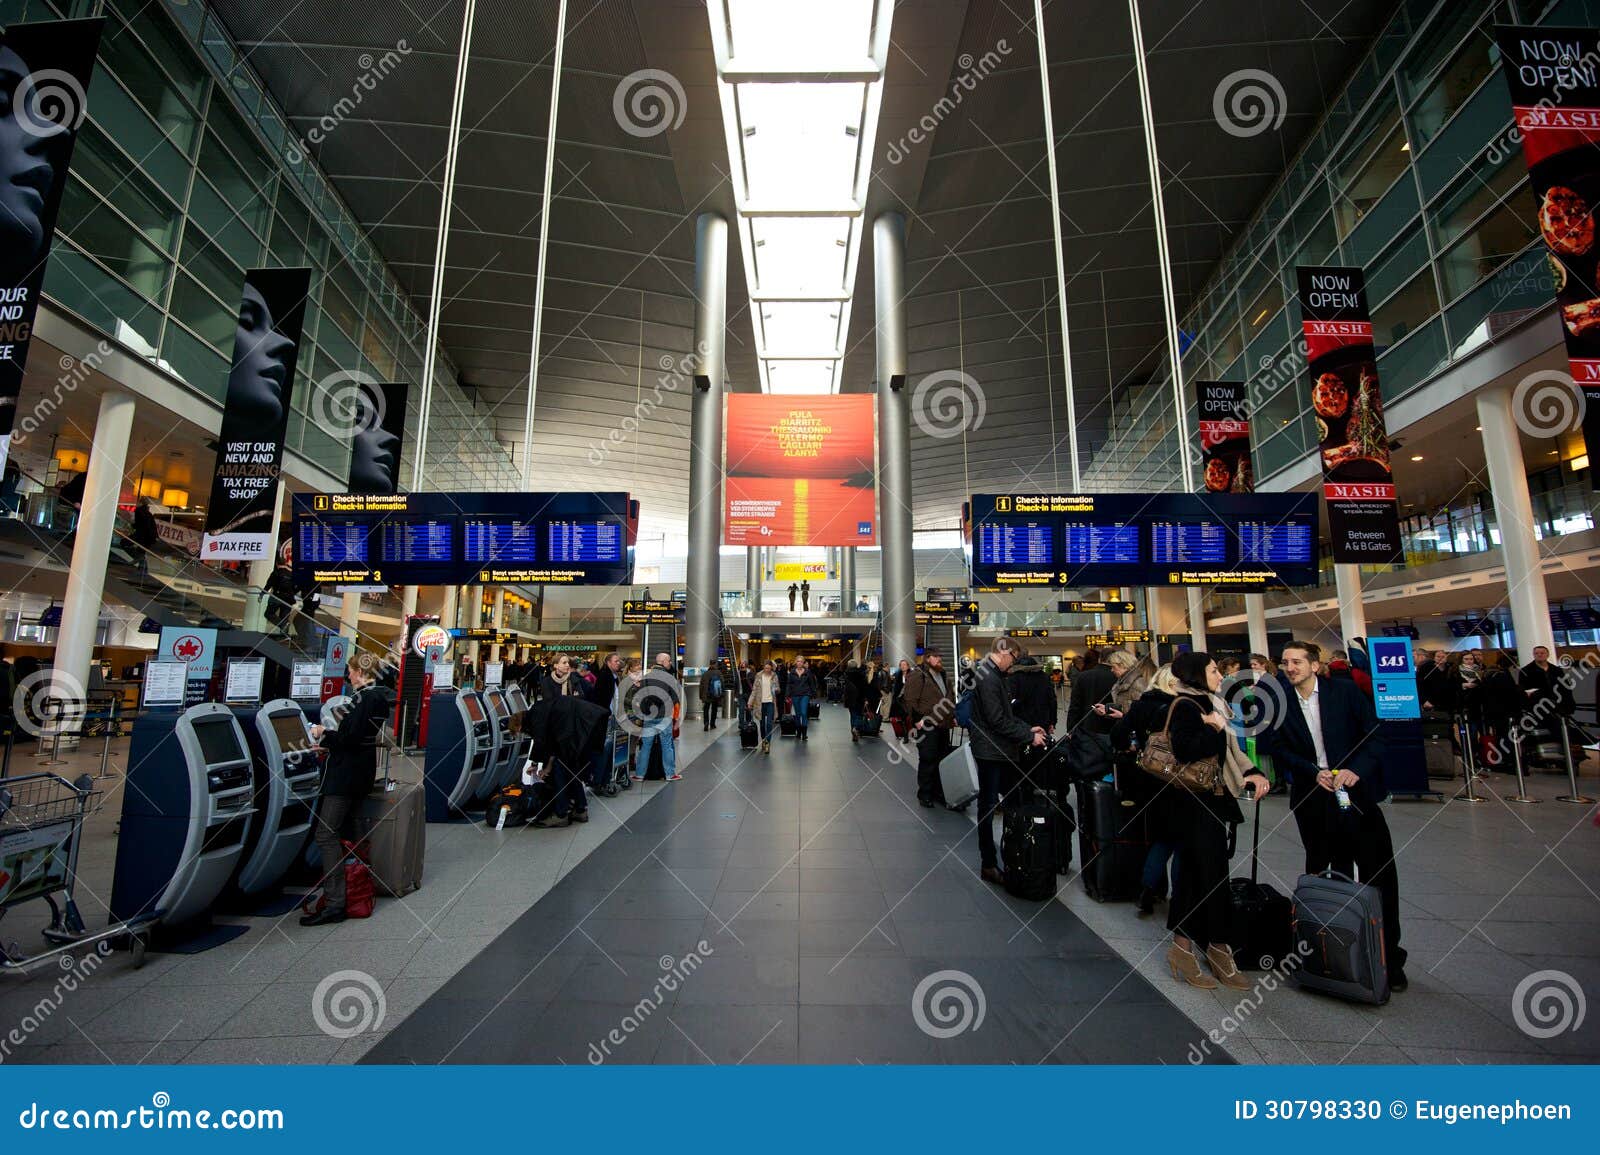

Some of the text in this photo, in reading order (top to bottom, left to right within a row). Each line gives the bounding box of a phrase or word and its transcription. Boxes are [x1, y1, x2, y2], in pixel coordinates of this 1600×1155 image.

[1520, 40, 1580, 60] NOW
[1520, 65, 1597, 87] OPEN!
[1312, 276, 1349, 290] NOW
[1310, 293, 1359, 308] OPEN!
[1312, 324, 1362, 333] MASH
[1206, 388, 1234, 399] NOW
[1205, 400, 1240, 411] OPEN!
[790, 411, 812, 419] PULA
[227, 442, 276, 452] VISIT OUR
[225, 454, 273, 463] NEW AND
[217, 465, 279, 476] AMAZING
[222, 478, 270, 487] TAX FREE
[230, 489, 258, 499] SHOP
[1334, 486, 1387, 496] MASH
[1016, 496, 1049, 504] Check-in
[1348, 531, 1385, 539] Between
[219, 542, 262, 551] TAX FREE
[1345, 542, 1392, 551] A & B Gates
[374, 571, 381, 581] 3
[1059, 573, 1067, 583] 3
[1379, 655, 1405, 667] SAS
